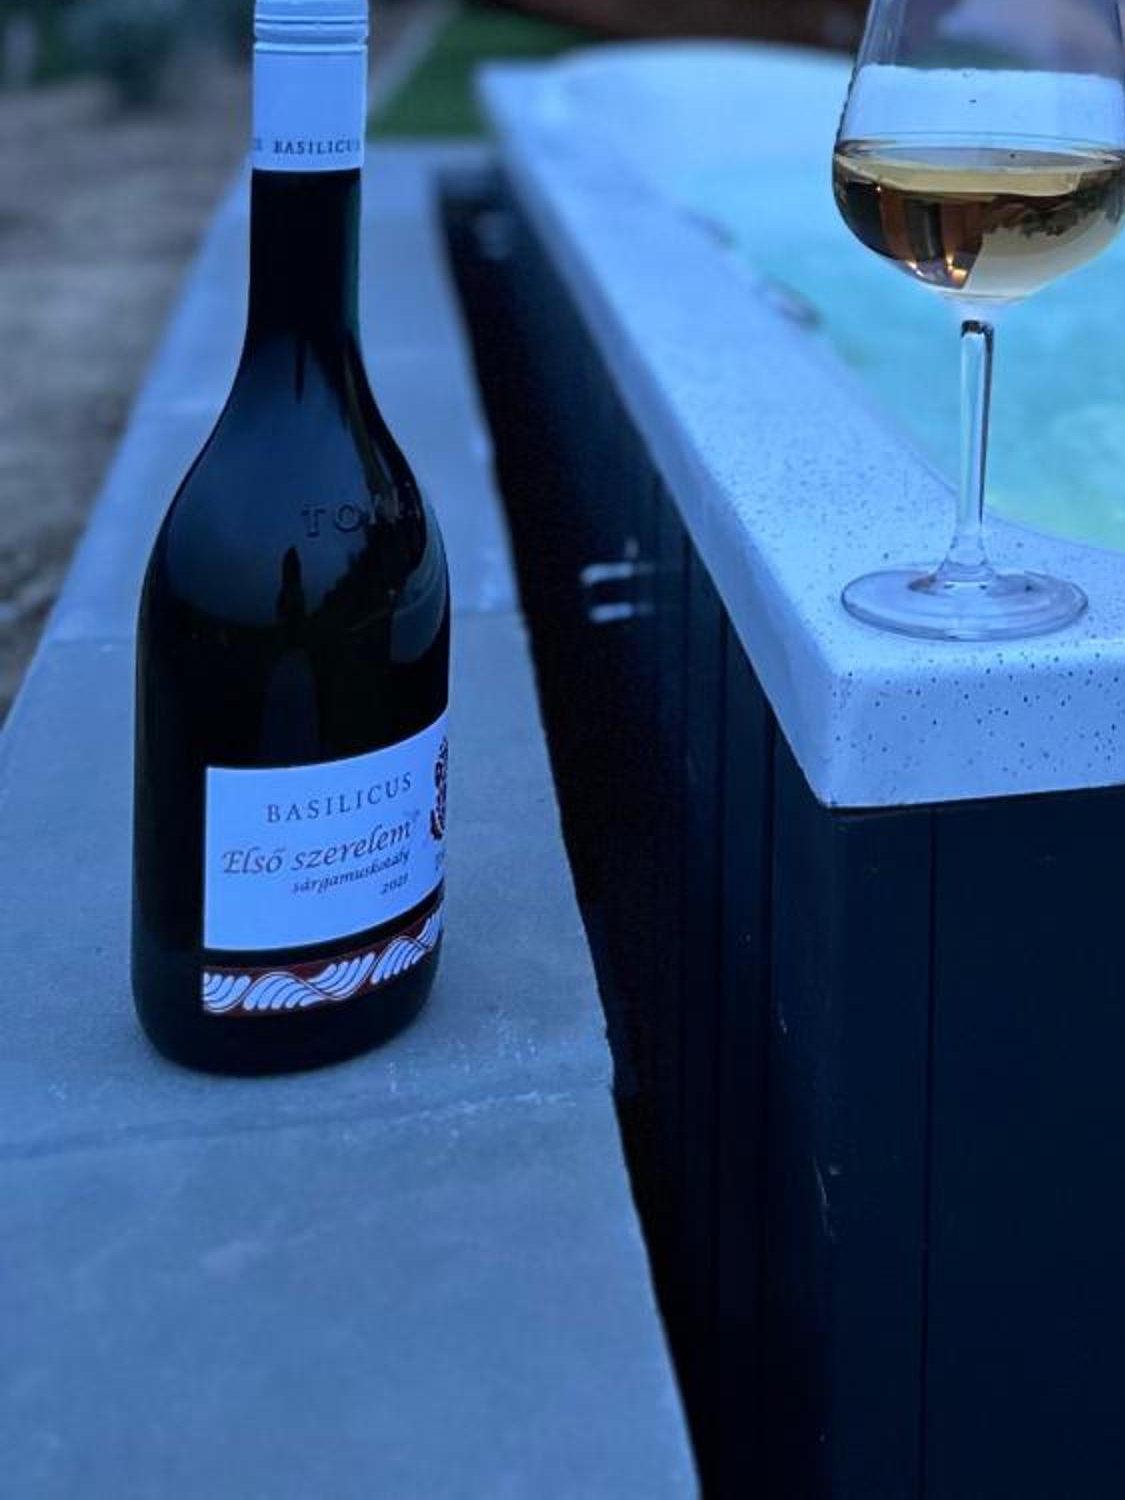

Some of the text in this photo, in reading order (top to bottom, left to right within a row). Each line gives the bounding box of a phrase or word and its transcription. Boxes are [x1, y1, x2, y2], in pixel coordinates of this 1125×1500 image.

[274, 138, 361, 155] BASILICU
[267, 772, 412, 823] BASILICUS
[222, 845, 286, 875] Első
[291, 818, 413, 871] szerelem
